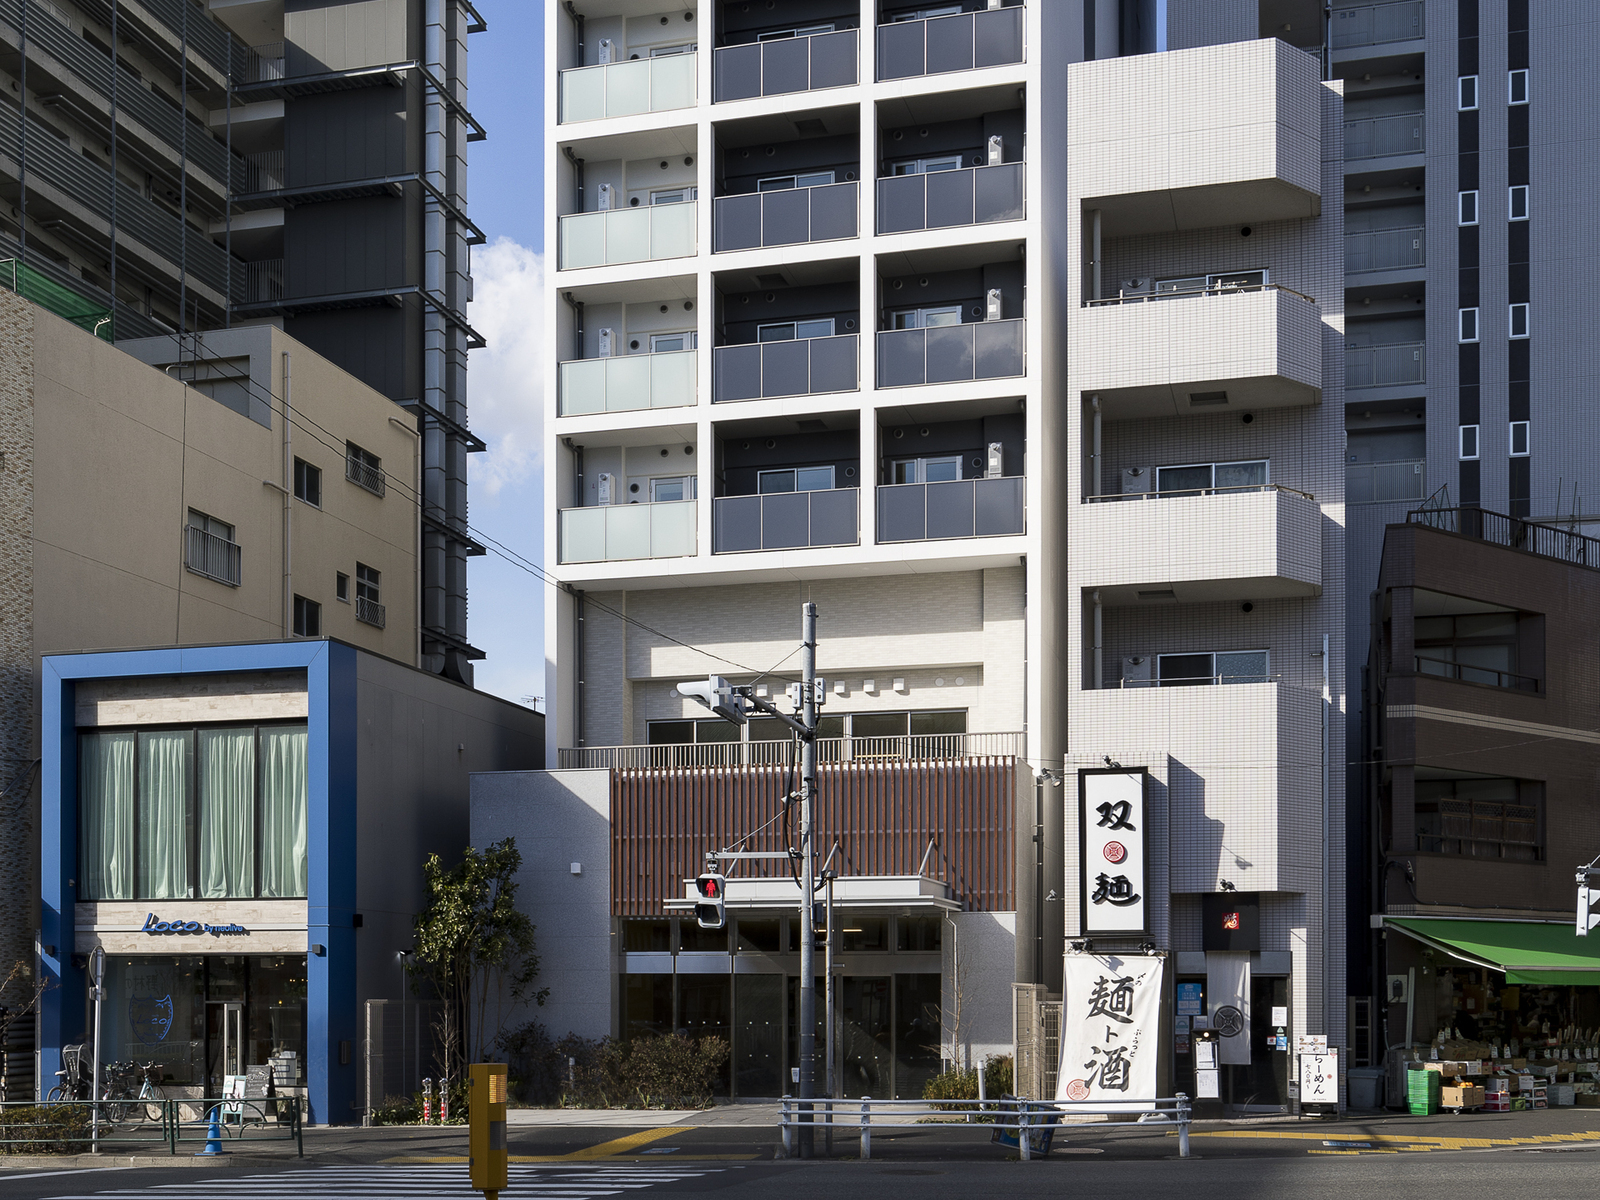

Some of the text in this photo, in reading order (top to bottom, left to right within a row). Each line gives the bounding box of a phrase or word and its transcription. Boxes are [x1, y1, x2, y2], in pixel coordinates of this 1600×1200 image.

[1092, 799, 1142, 907] 双麺
[203, 923, 214, 934] by
[214, 923, 243, 932] neolive
[1083, 975, 1135, 1093] 麺ト酒
[1313, 1055, 1325, 1095] らーめん
